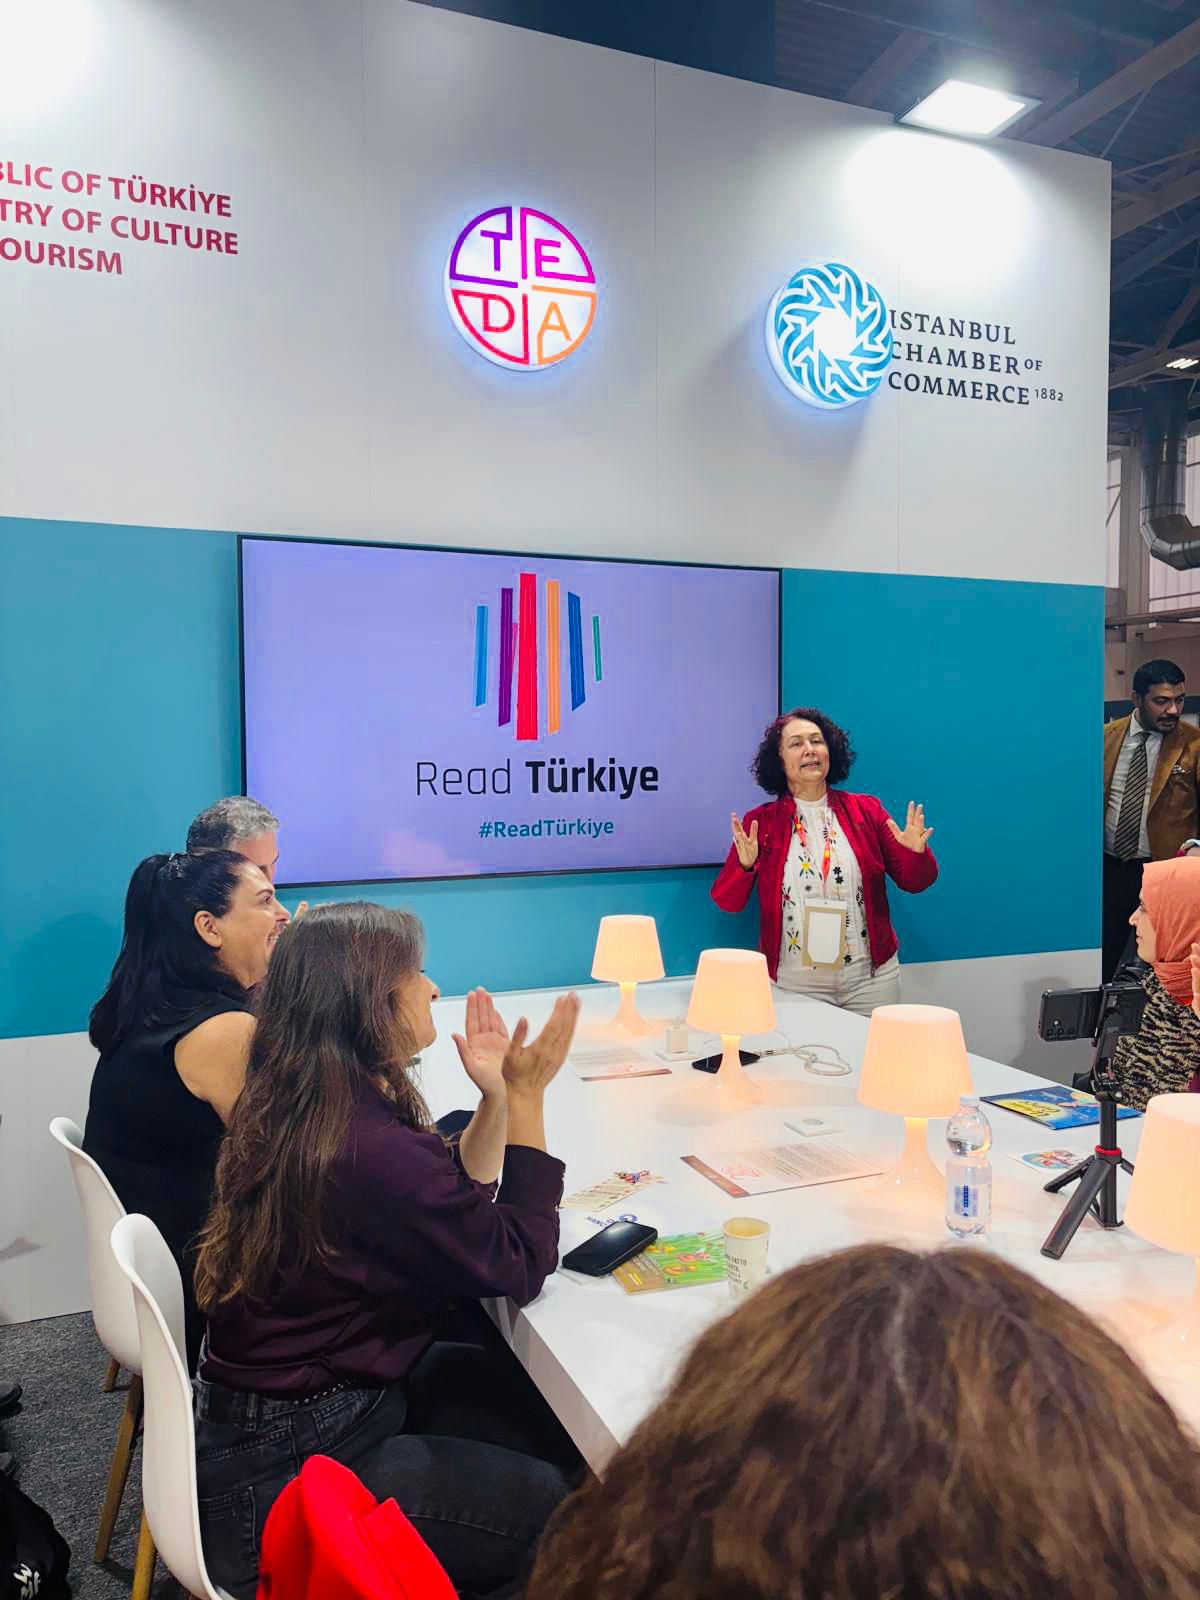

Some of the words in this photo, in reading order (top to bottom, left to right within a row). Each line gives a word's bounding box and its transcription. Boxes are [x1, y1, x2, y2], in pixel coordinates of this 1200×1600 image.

[0, 161, 53, 190] LIC
[61, 170, 102, 196] OF
[108, 174, 232, 218] TÜRKİYE
[61, 208, 102, 234] OF
[110, 215, 239, 255] CULTURE
[0, 237, 123, 275] OURISM
[889, 309, 1016, 345] ISTANBUL
[891, 340, 1021, 376] CHAMBER
[1024, 358, 1043, 371] OF
[888, 371, 1030, 406] COMMERCE
[1034, 388, 1064, 402] 1882
[416, 758, 511, 796] Read
[525, 757, 659, 800] Türkiye
[479, 818, 614, 838] #ReadTürkiye
